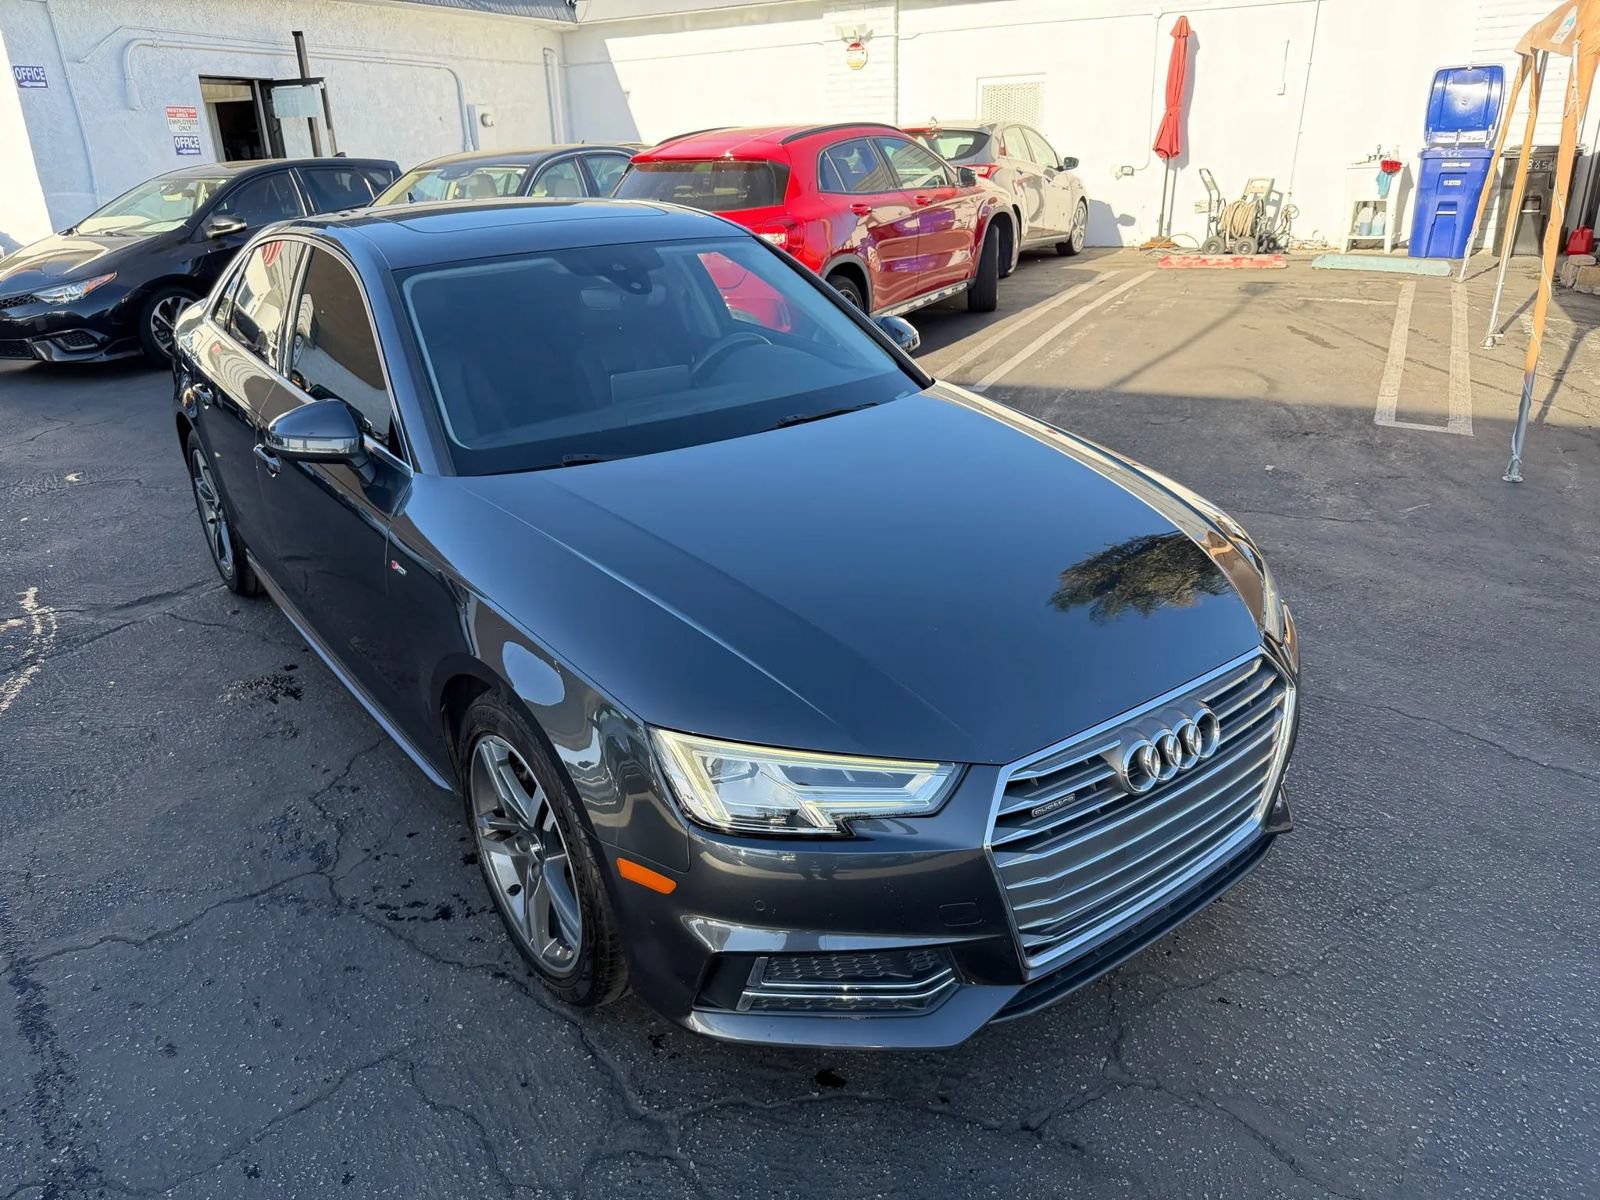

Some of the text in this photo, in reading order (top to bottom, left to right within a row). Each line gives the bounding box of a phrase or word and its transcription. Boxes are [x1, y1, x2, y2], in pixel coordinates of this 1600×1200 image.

[14, 66, 46, 80] OFFICE
[174, 136, 200, 149] OFFICE
[1033, 795, 1074, 816] quattro
